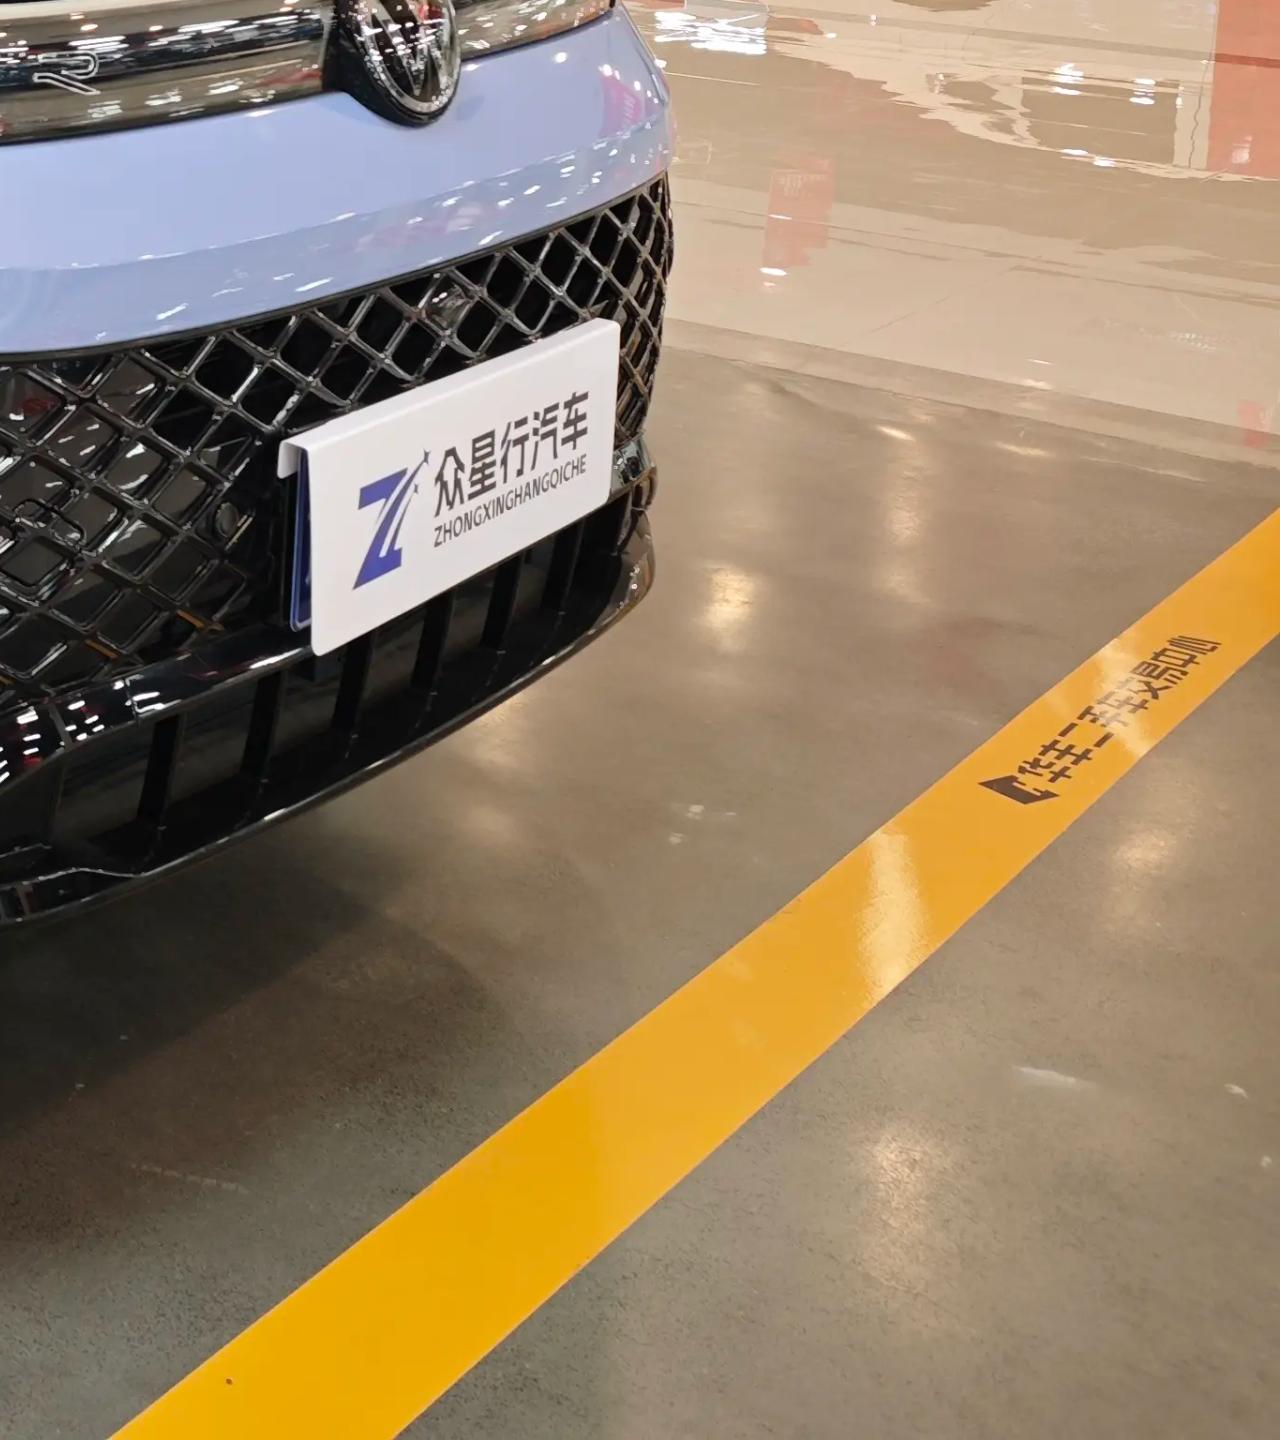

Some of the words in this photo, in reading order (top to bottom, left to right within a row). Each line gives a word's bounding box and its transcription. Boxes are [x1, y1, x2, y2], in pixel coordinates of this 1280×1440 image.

[433, 390, 590, 518] 众星行汽车
[433, 453, 588, 549] ZHONGXINGHANGQICHE
